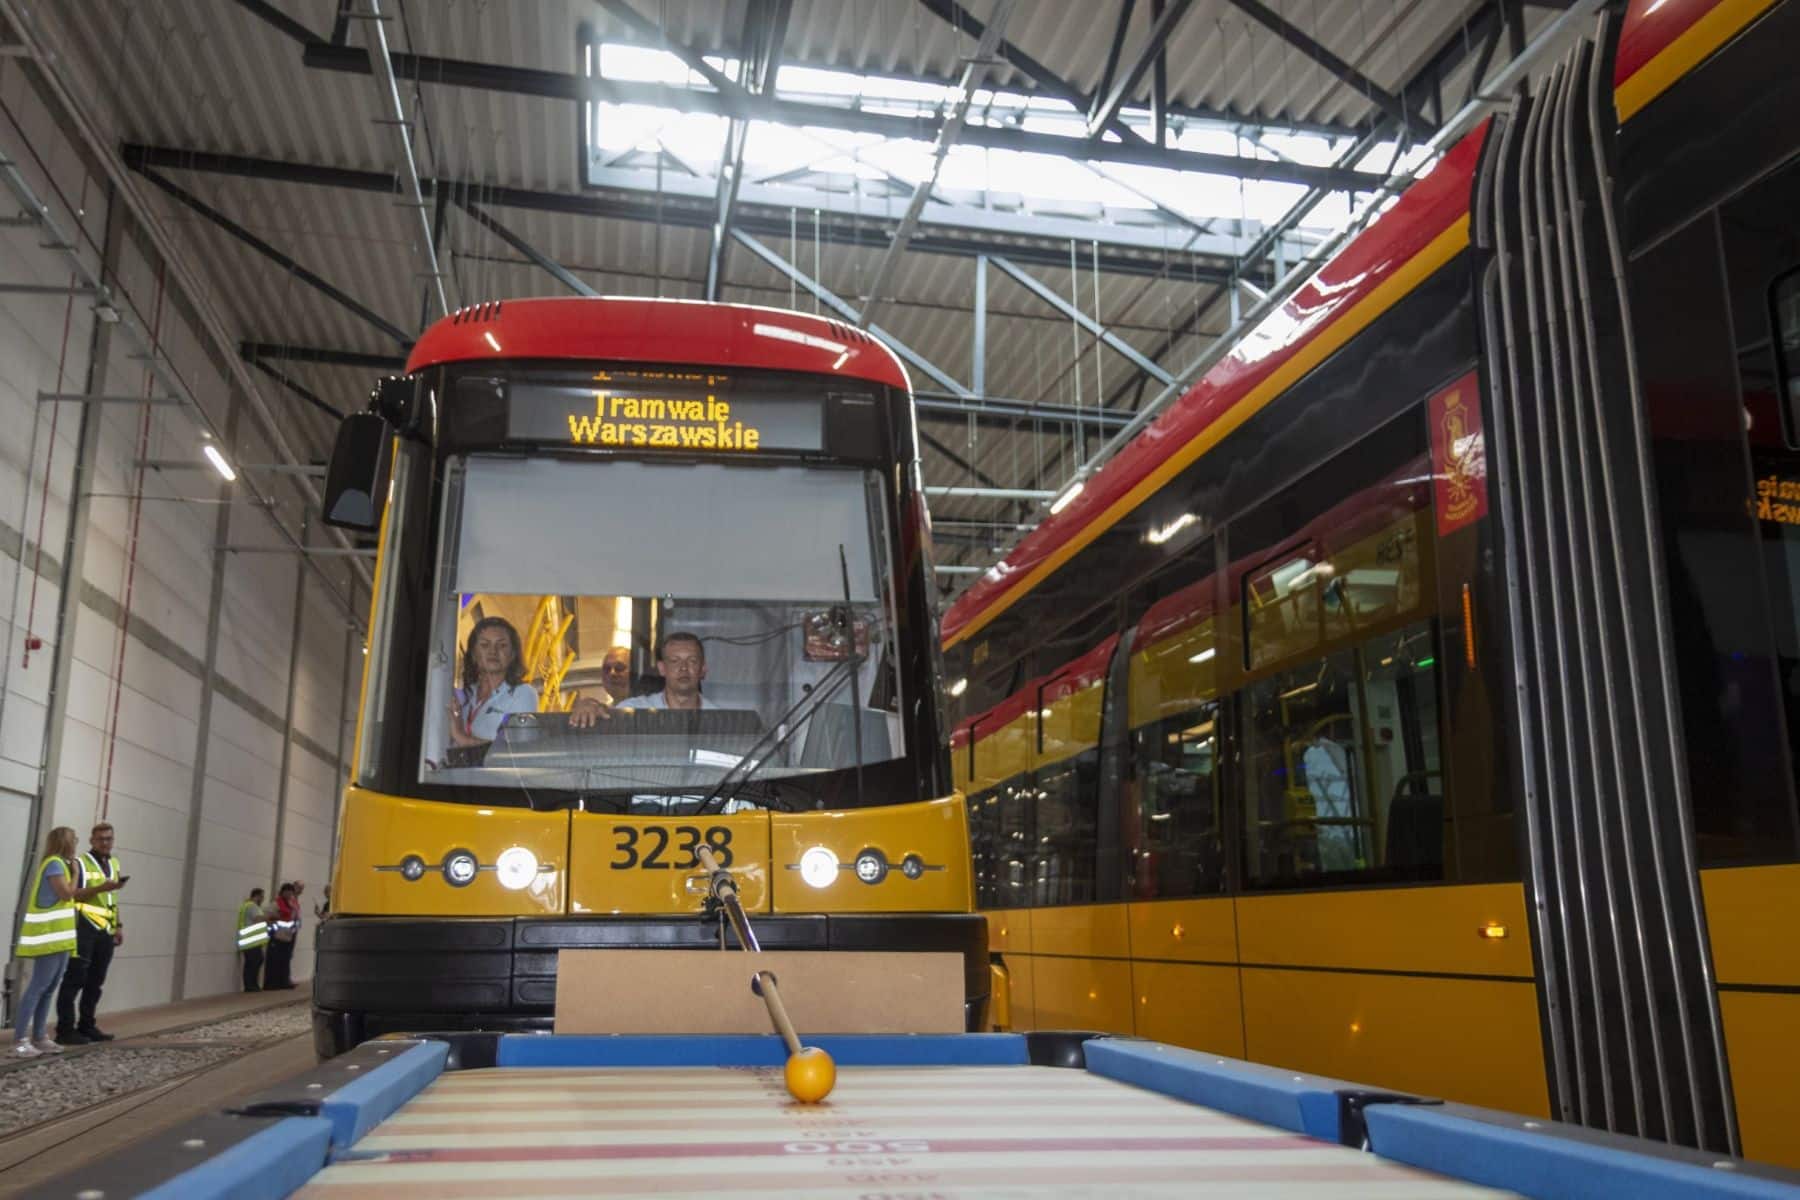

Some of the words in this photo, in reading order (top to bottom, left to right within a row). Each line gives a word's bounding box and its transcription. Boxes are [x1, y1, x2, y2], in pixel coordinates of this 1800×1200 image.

[568, 415, 760, 449] Warszawskie
[610, 826, 733, 870] 3238
[784, 1139, 929, 1152] 500
